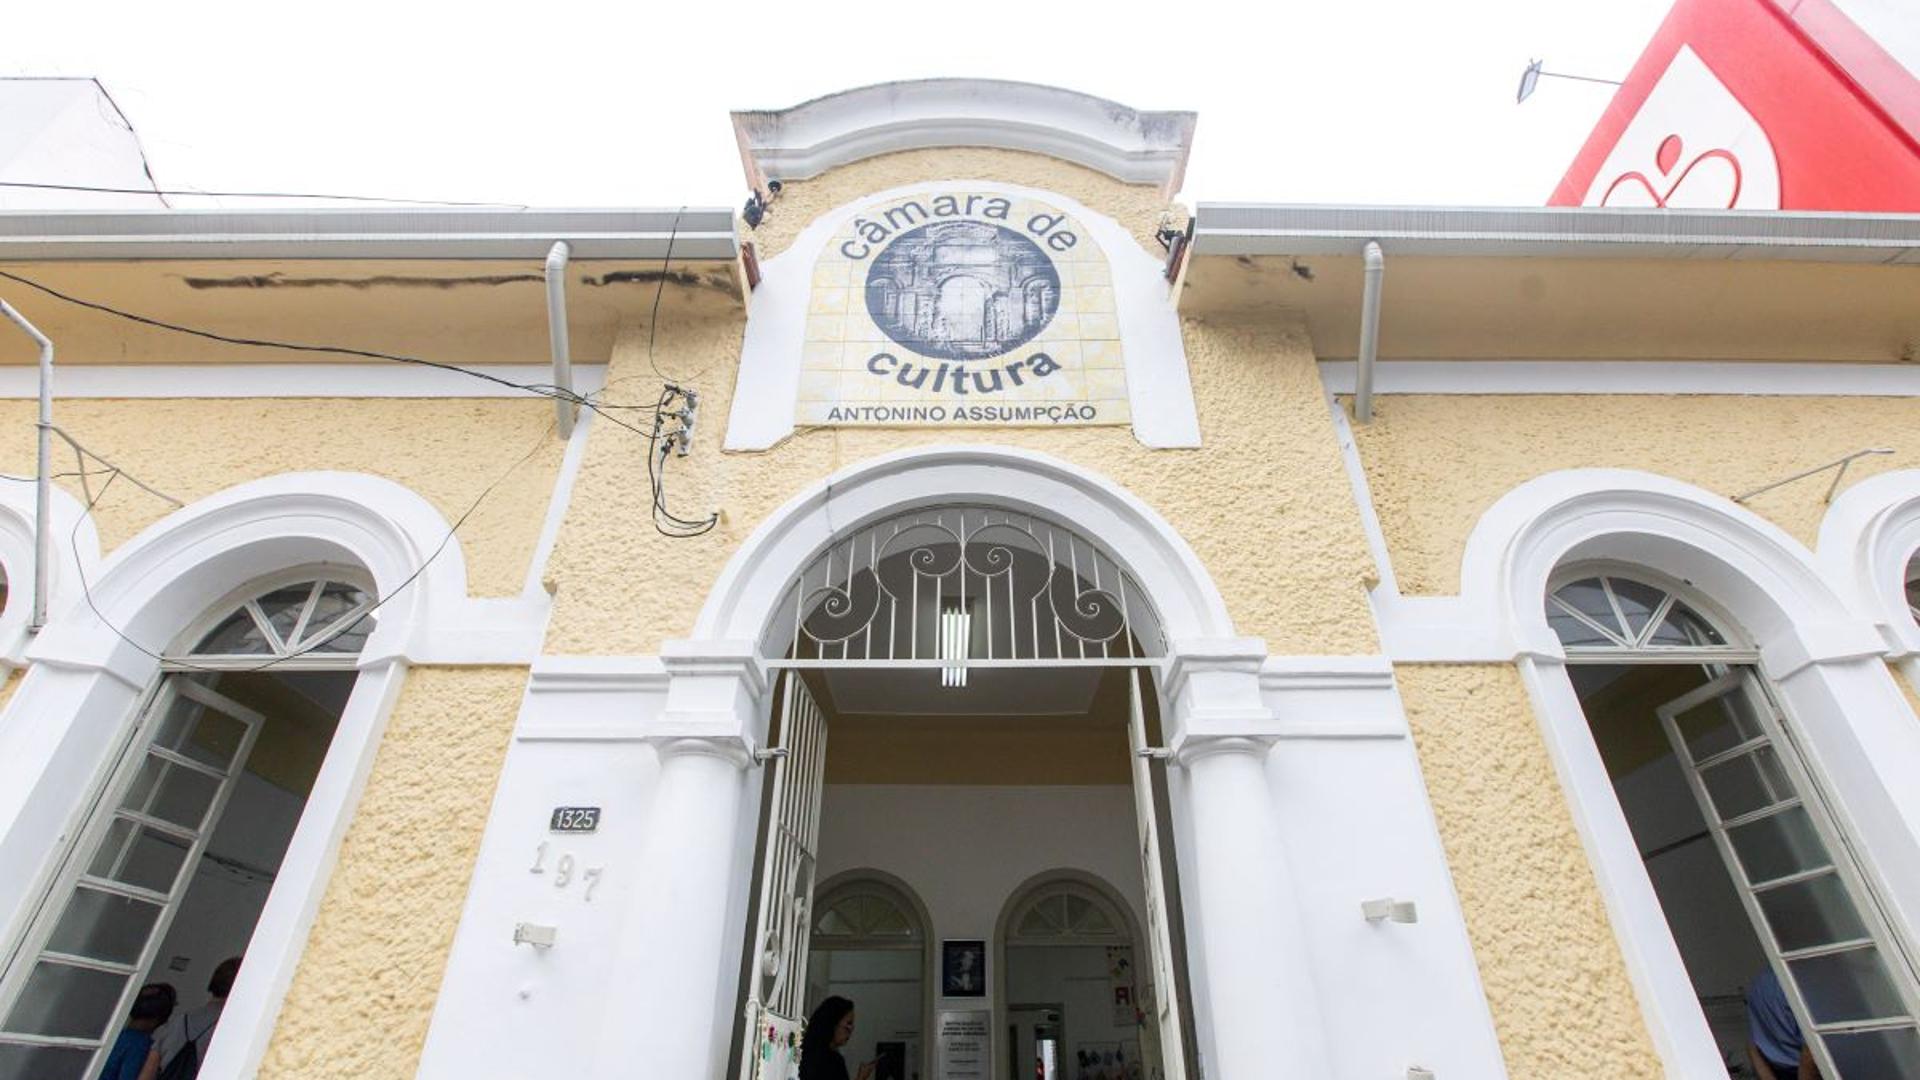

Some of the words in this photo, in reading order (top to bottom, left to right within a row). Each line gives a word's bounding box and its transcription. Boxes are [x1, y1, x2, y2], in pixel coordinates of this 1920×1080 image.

[841, 195, 1010, 261] câmara
[1027, 211, 1077, 252] de
[867, 352, 1061, 395] cultura
[828, 406, 947, 422] ANTONINO
[952, 403, 1097, 424] ASSUMPÇÃO
[556, 809, 596, 829] 1325
[529, 840, 605, 902] 197
